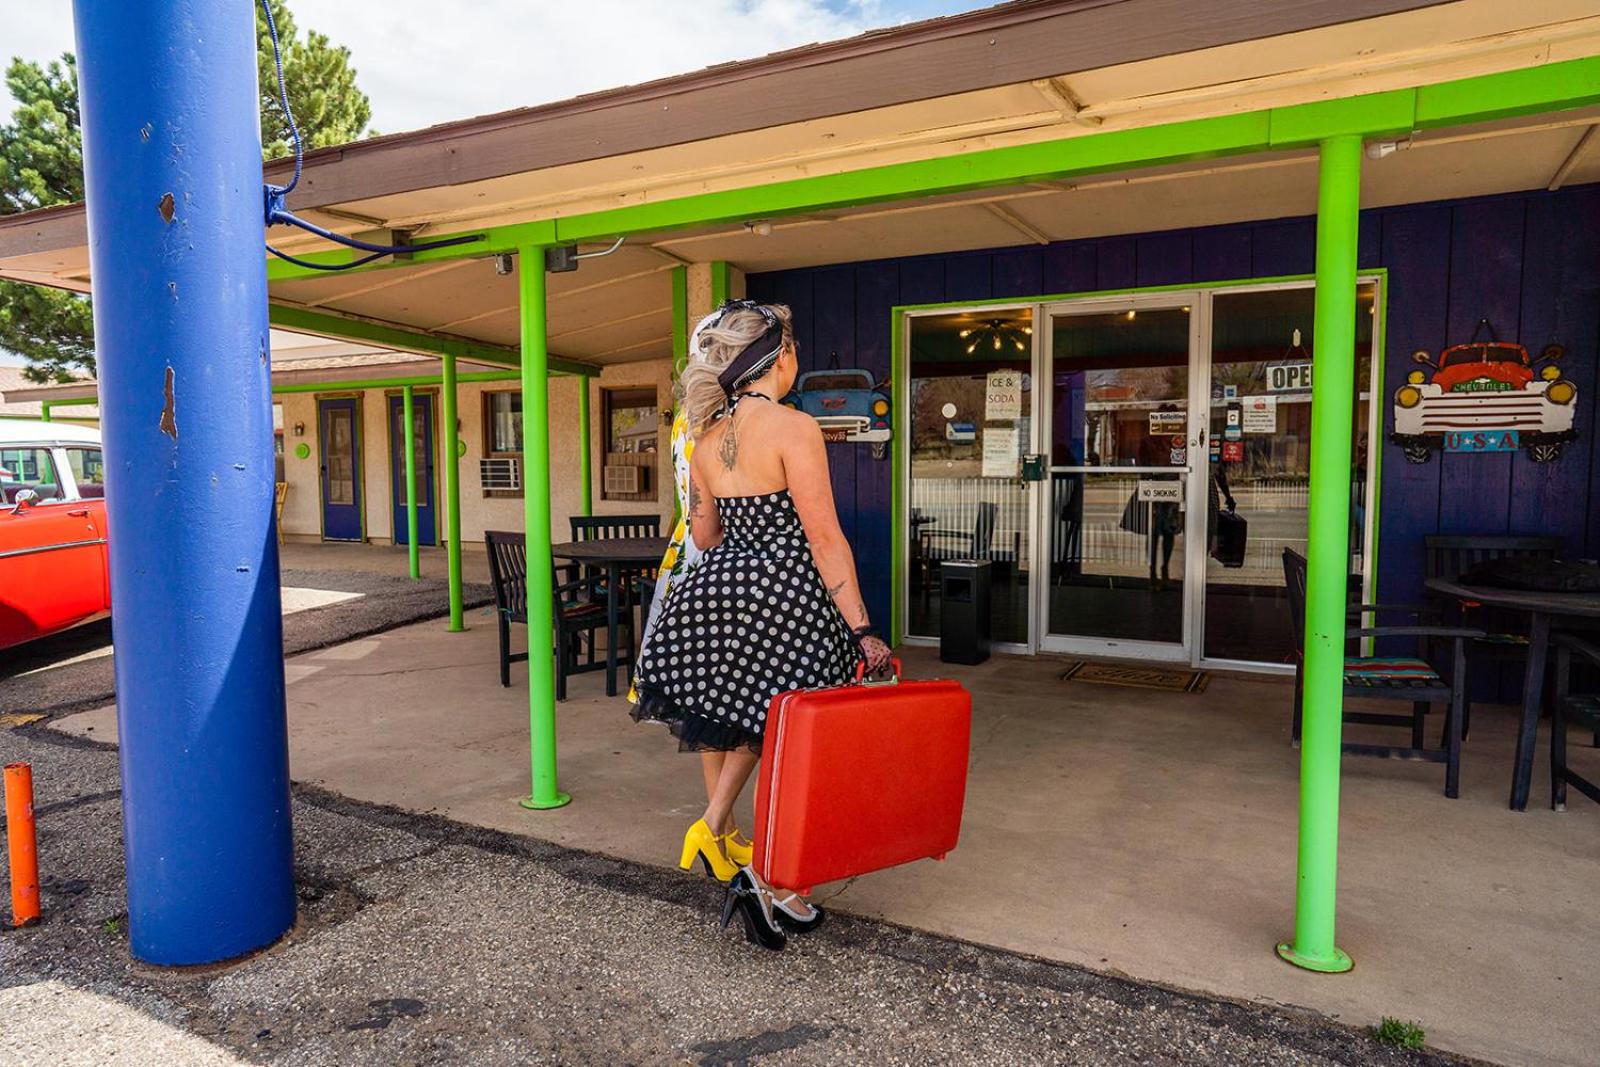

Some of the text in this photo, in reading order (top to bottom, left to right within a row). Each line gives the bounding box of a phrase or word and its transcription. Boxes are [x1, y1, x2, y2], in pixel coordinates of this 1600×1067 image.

[1272, 365, 1313, 389] OPE
[989, 378, 1013, 387] ICE &
[1454, 382, 1512, 391] CHEVROLET
[989, 394, 1015, 403] SODA
[1160, 413, 1186, 421] Soliciting
[1143, 489, 1178, 497] NO SMOKING
